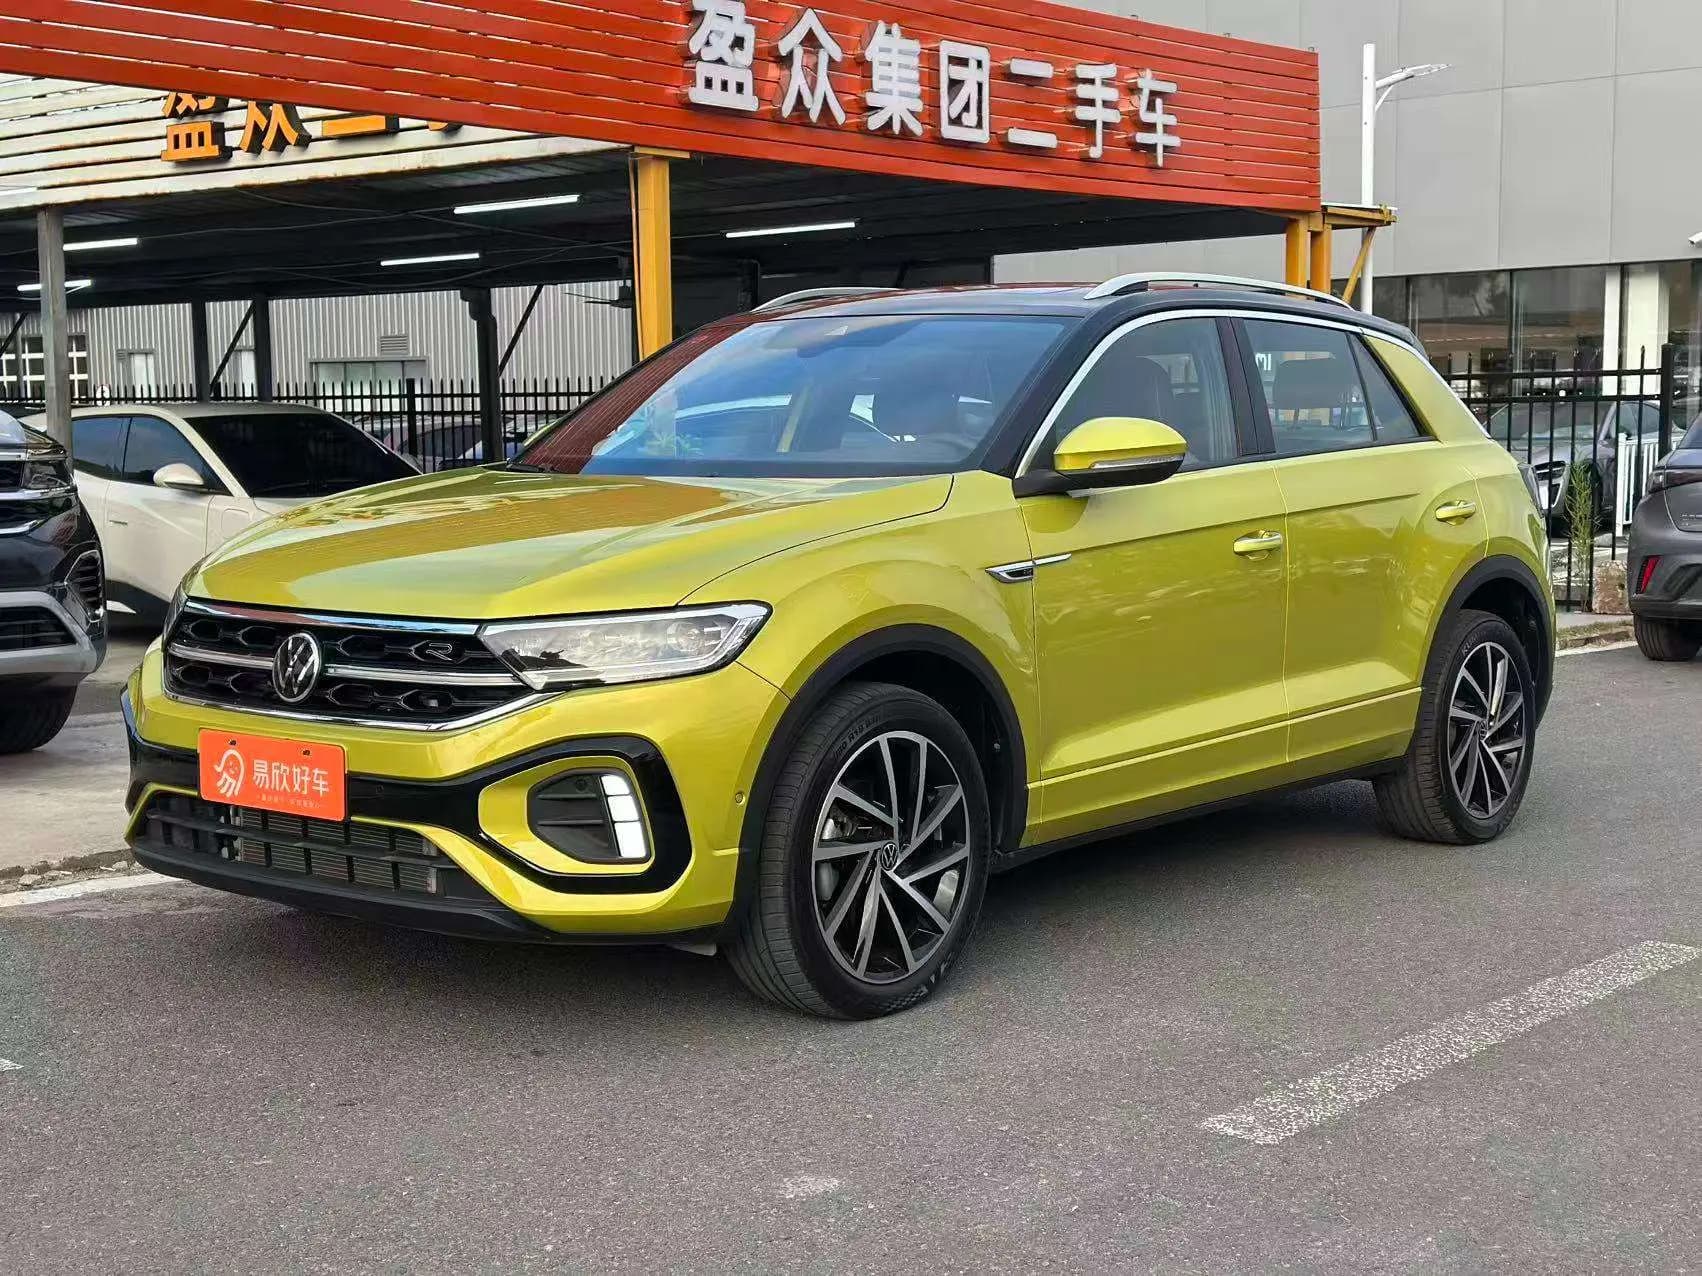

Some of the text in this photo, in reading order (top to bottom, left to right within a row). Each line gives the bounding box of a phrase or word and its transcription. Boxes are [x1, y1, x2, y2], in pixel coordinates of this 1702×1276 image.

[688, 0, 1182, 168] 盈众集团二手车
[252, 759, 329, 797] 易欣好车
